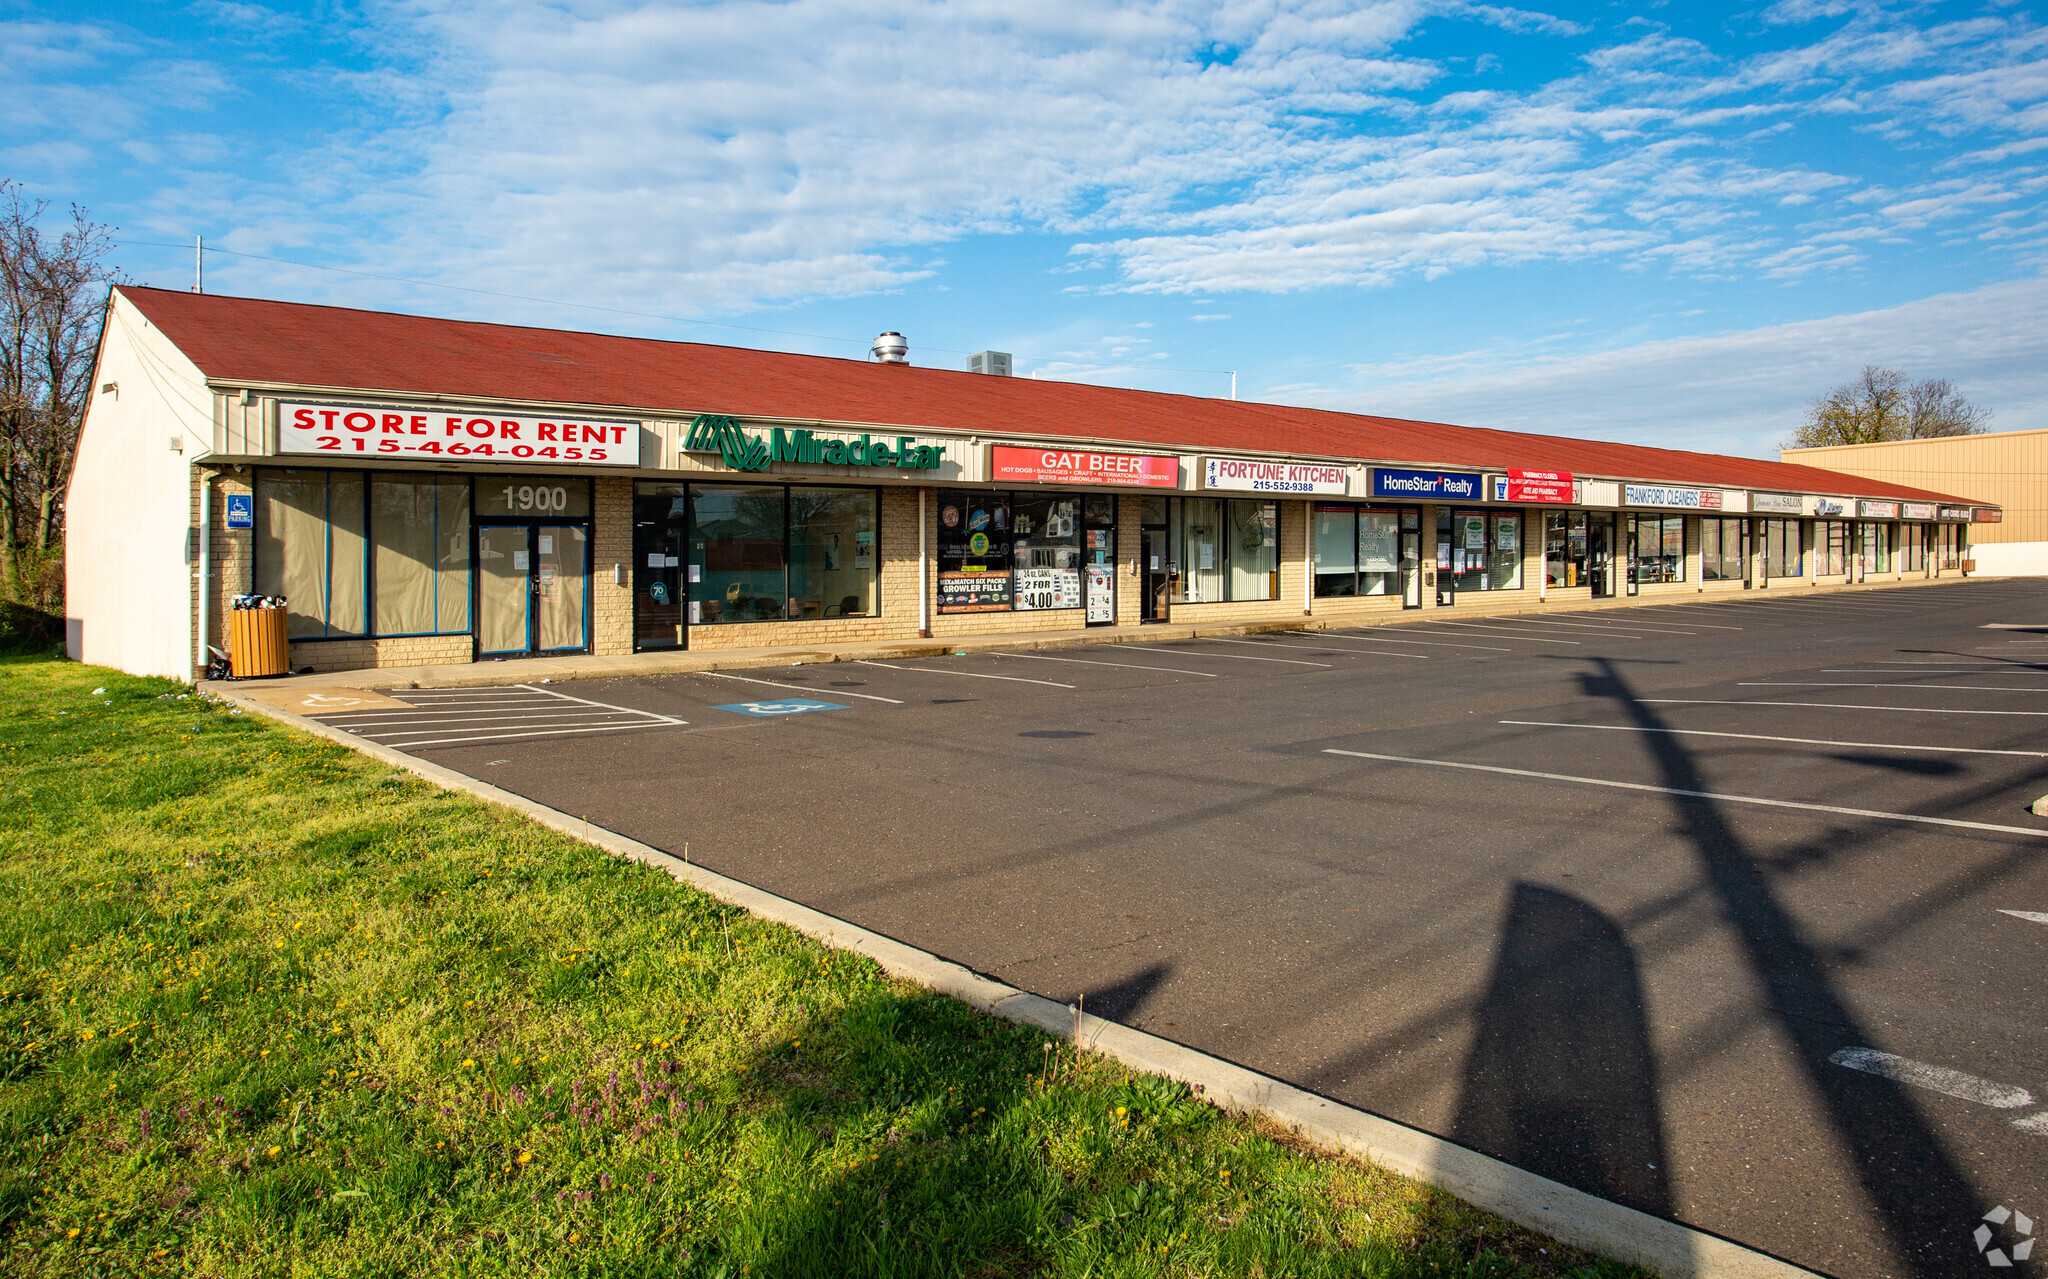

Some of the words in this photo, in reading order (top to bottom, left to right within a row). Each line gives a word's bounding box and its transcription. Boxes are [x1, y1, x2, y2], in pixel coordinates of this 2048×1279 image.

[293, 408, 427, 435] STORE
[446, 417, 522, 439] FOR
[537, 422, 627, 444] RENT
[315, 436, 608, 461] 215-464-0455
[770, 427, 946, 469] Miracle-Ear
[1041, 452, 1085, 470] GAT
[1089, 454, 1143, 473] BEER
[1220, 461, 1284, 480] FORTUNE
[1288, 466, 1344, 484] KITCHEN
[1253, 480, 1314, 492] 215-552-9388
[1384, 475, 1438, 492] HomeStarr
[1444, 478, 1473, 496] Realty
[502, 486, 566, 510] 1900
[1626, 487, 1664, 504] FRANKFORD
[1666, 489, 1698, 506] CLEANERS
[1782, 496, 1802, 508] SALON
[1360, 530, 1393, 540] HomeStarr
[1360, 542, 1380, 553] Realty
[1038, 570, 1051, 578] CANS
[653, 586, 664, 596] 70
[943, 584, 981, 592] GROWLER
[982, 584, 1004, 592] FILLS
[1025, 581, 1031, 590] 2
[1033, 580, 1050, 588] FOR
[1024, 592, 1052, 608] $4.00
